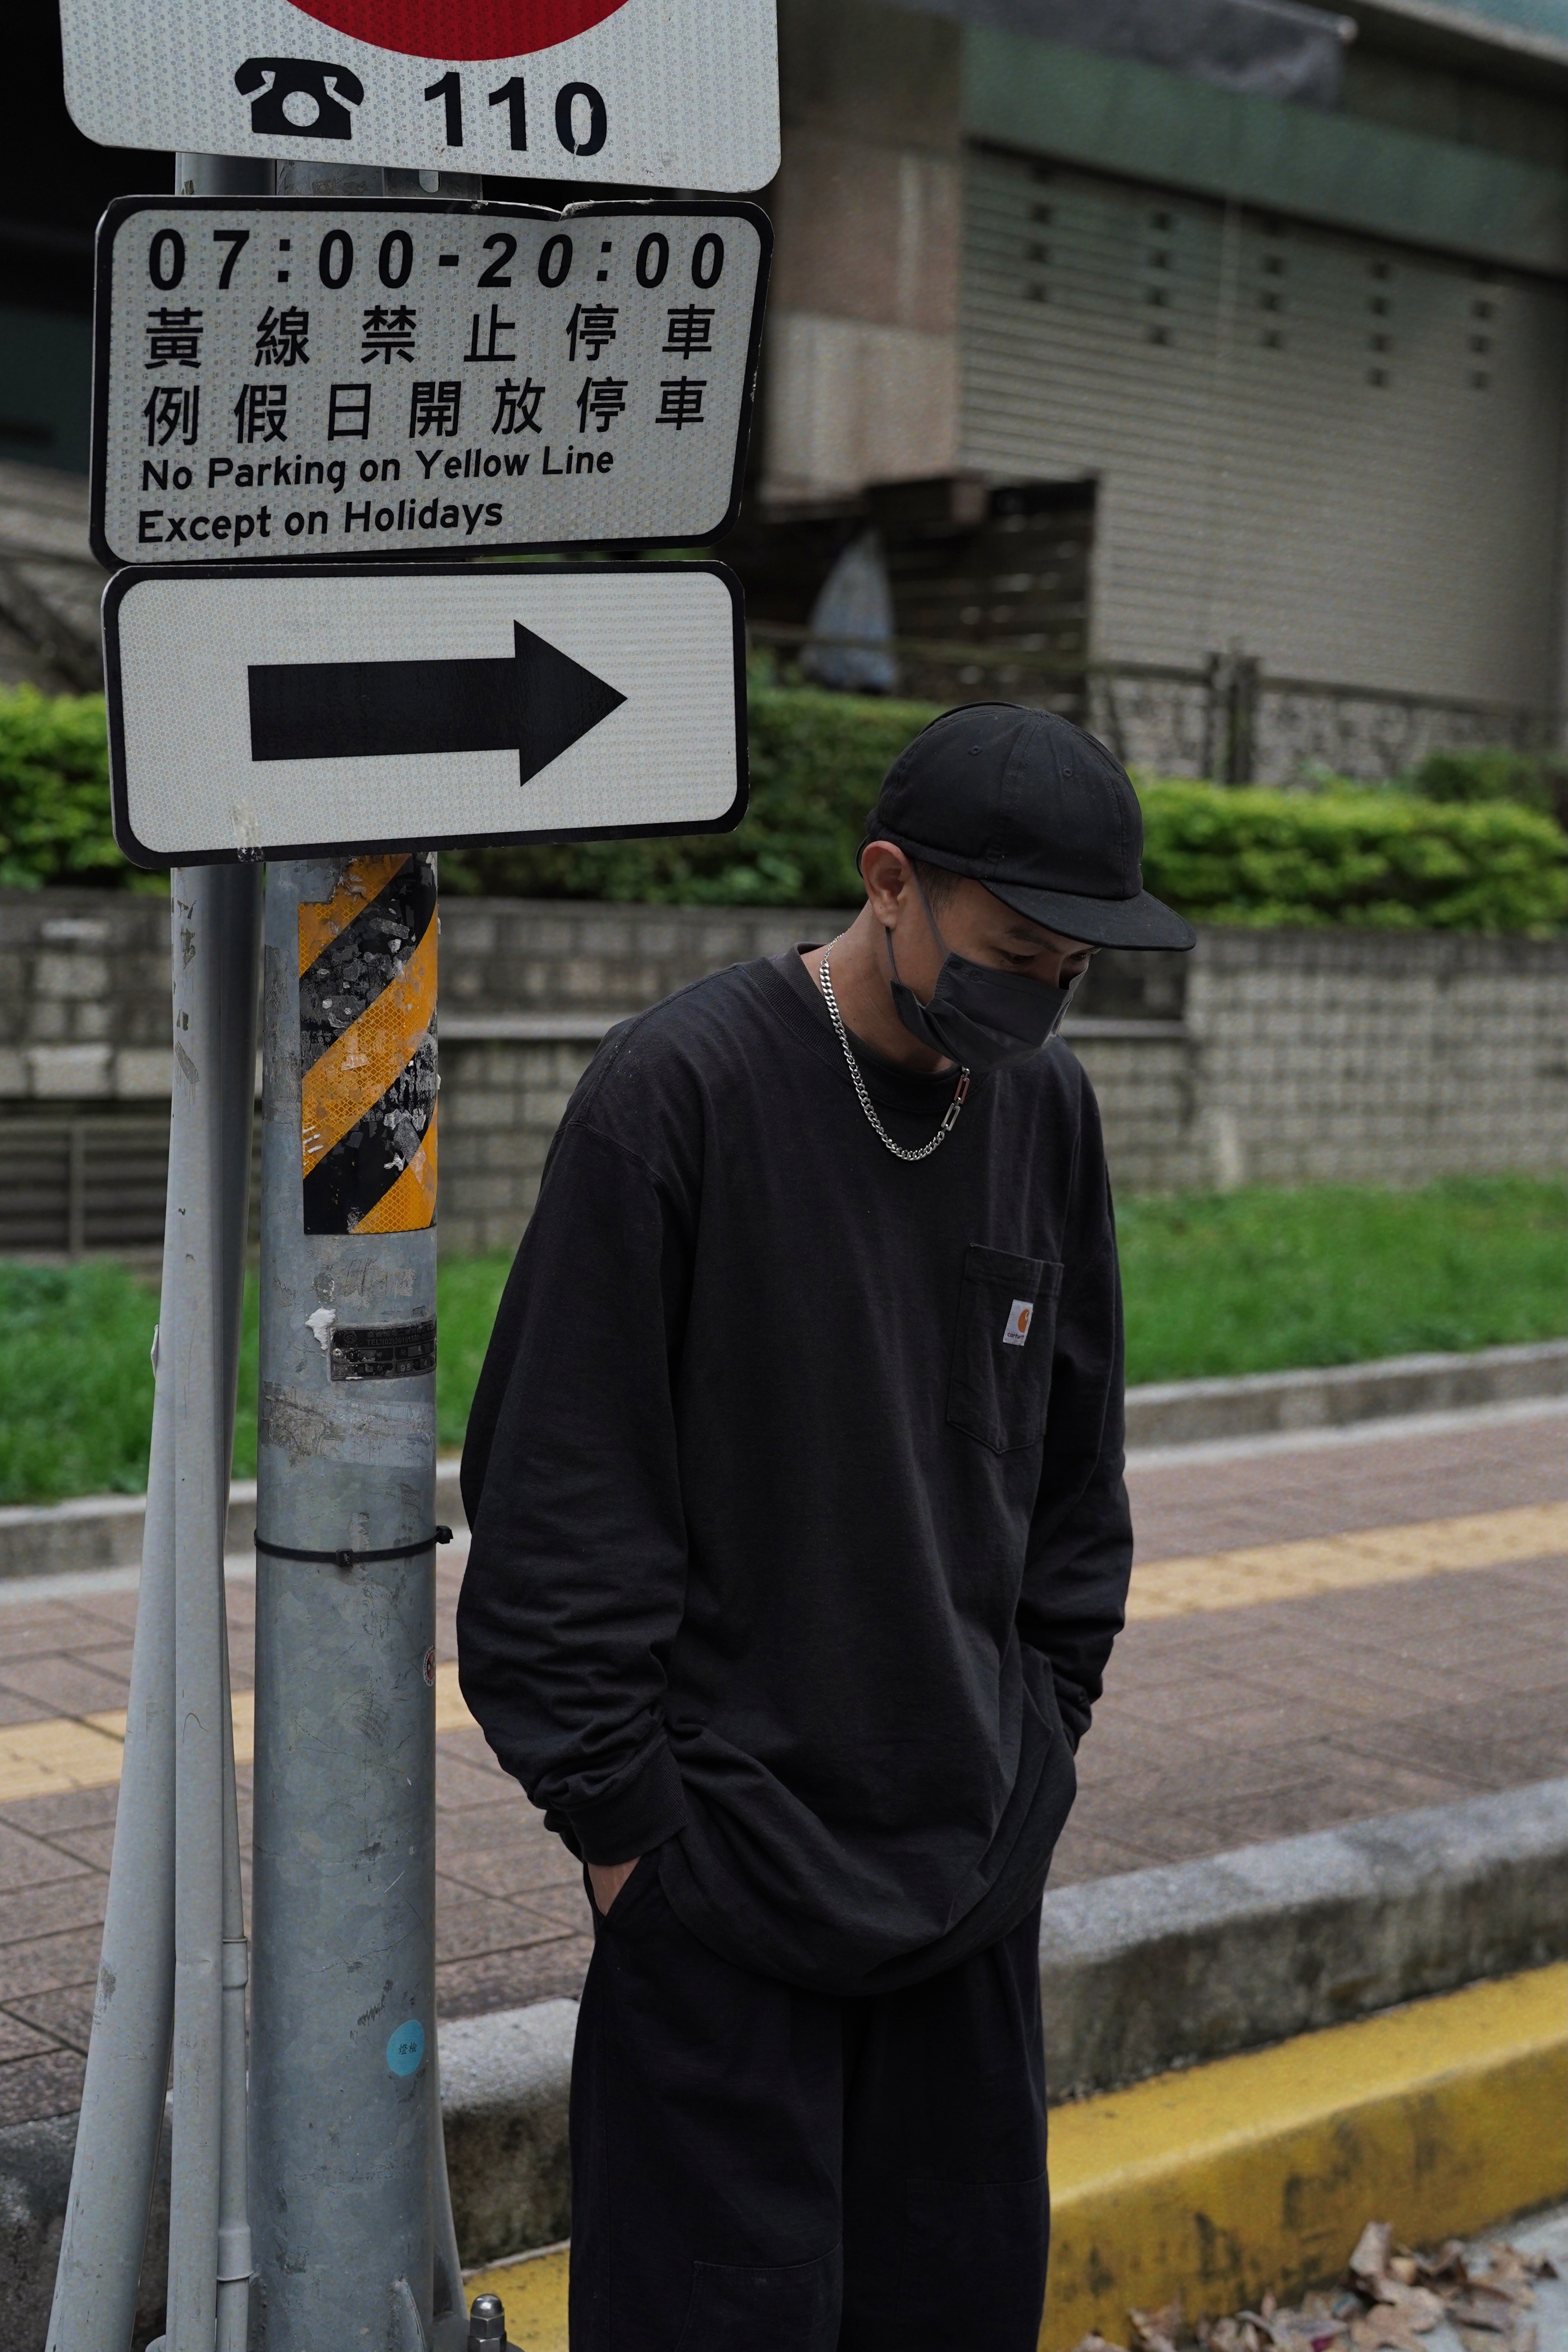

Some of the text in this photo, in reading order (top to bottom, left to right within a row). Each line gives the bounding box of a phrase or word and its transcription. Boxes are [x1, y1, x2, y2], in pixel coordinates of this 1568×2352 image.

[424, 71, 608, 157] 110
[147, 228, 725, 292] 07:00-20:00
[144, 302, 716, 371] 黃線禁止停車
[142, 375, 708, 447] 例假日開放停車
[141, 445, 614, 494] No Parking on Yellow Line
[138, 497, 503, 548] Except on Holidays
[400, 1363, 411, 1372] 98
[418, 1346, 422, 1355] 5
[398, 2042, 417, 2055] 燈檢
